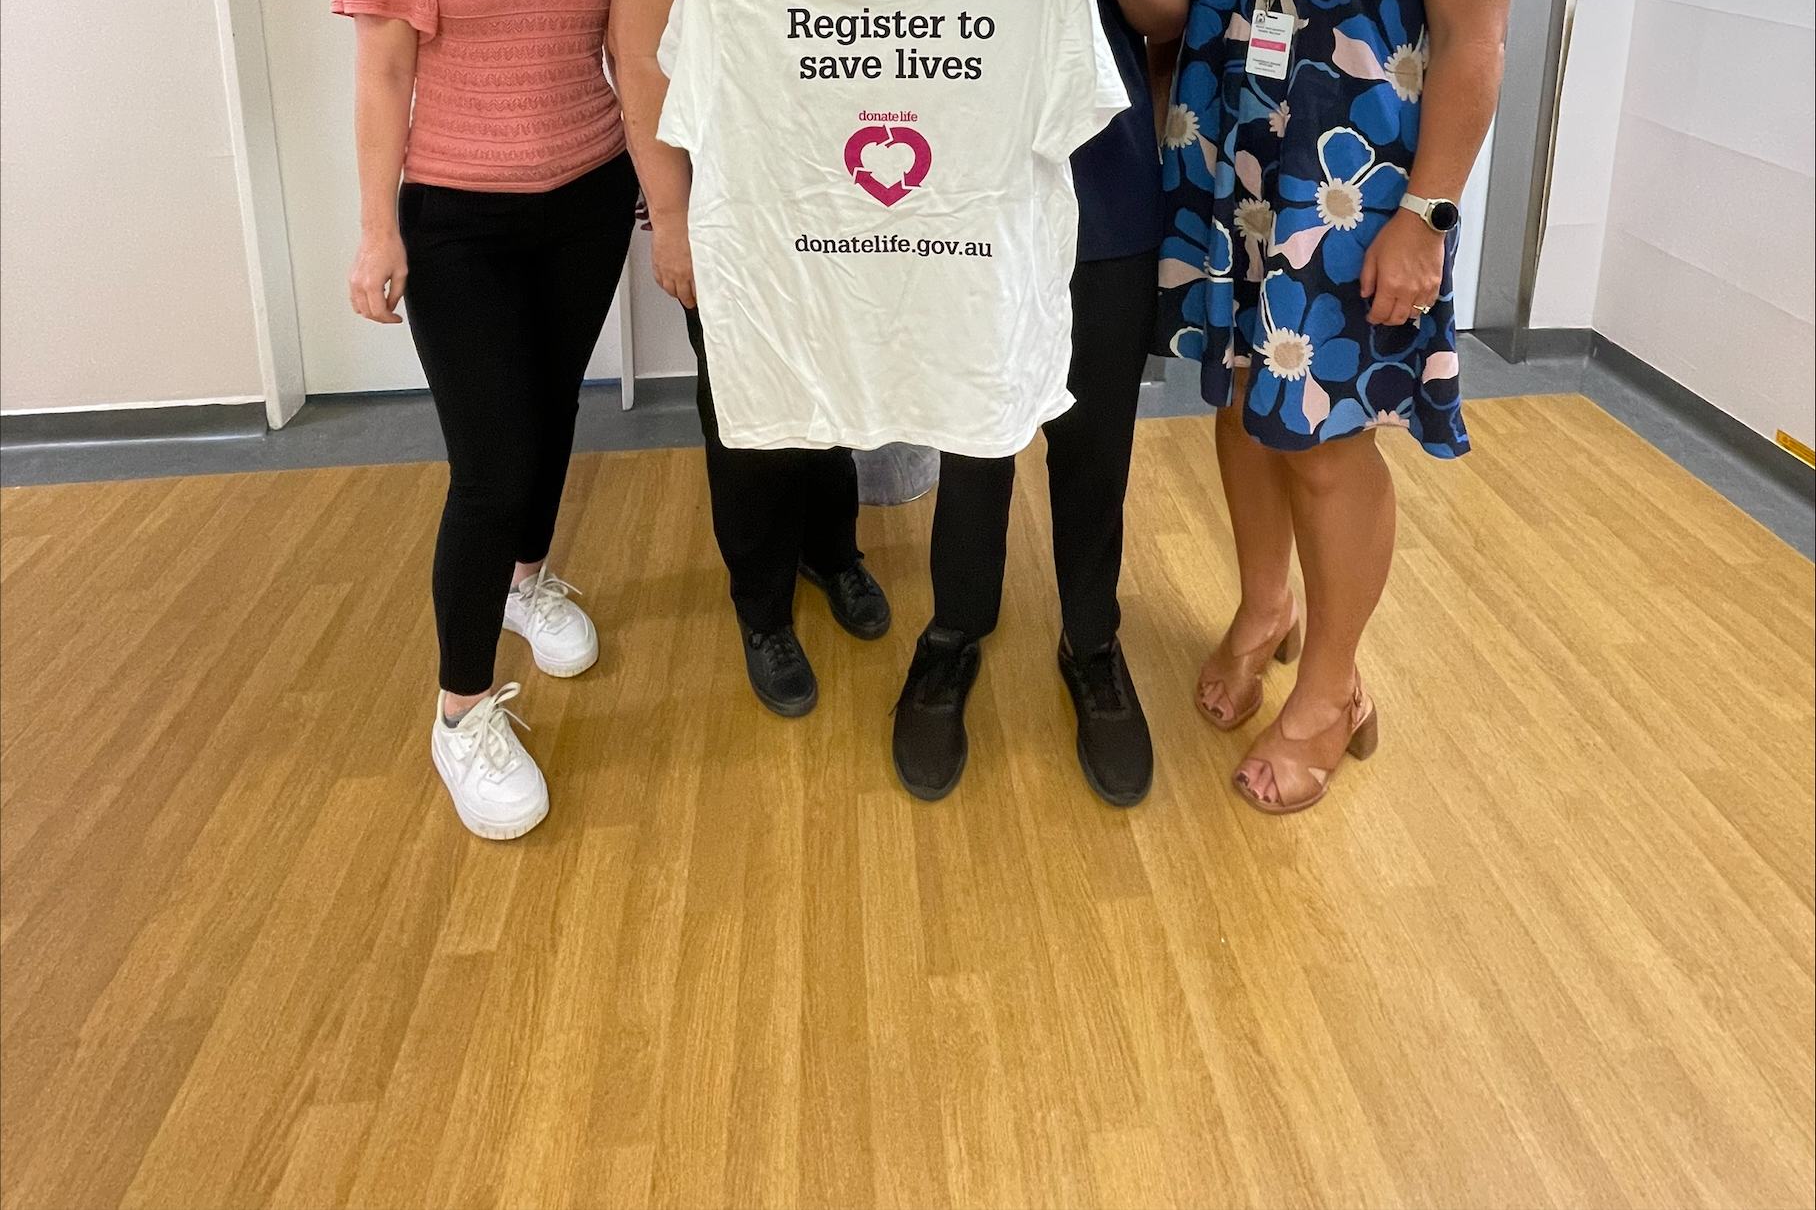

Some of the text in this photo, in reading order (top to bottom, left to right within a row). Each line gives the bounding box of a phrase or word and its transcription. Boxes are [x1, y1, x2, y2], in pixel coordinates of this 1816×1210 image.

[787, 8, 995, 46] Register to
[799, 49, 982, 80] save lives
[794, 233, 993, 258] donatelife.gov.au
